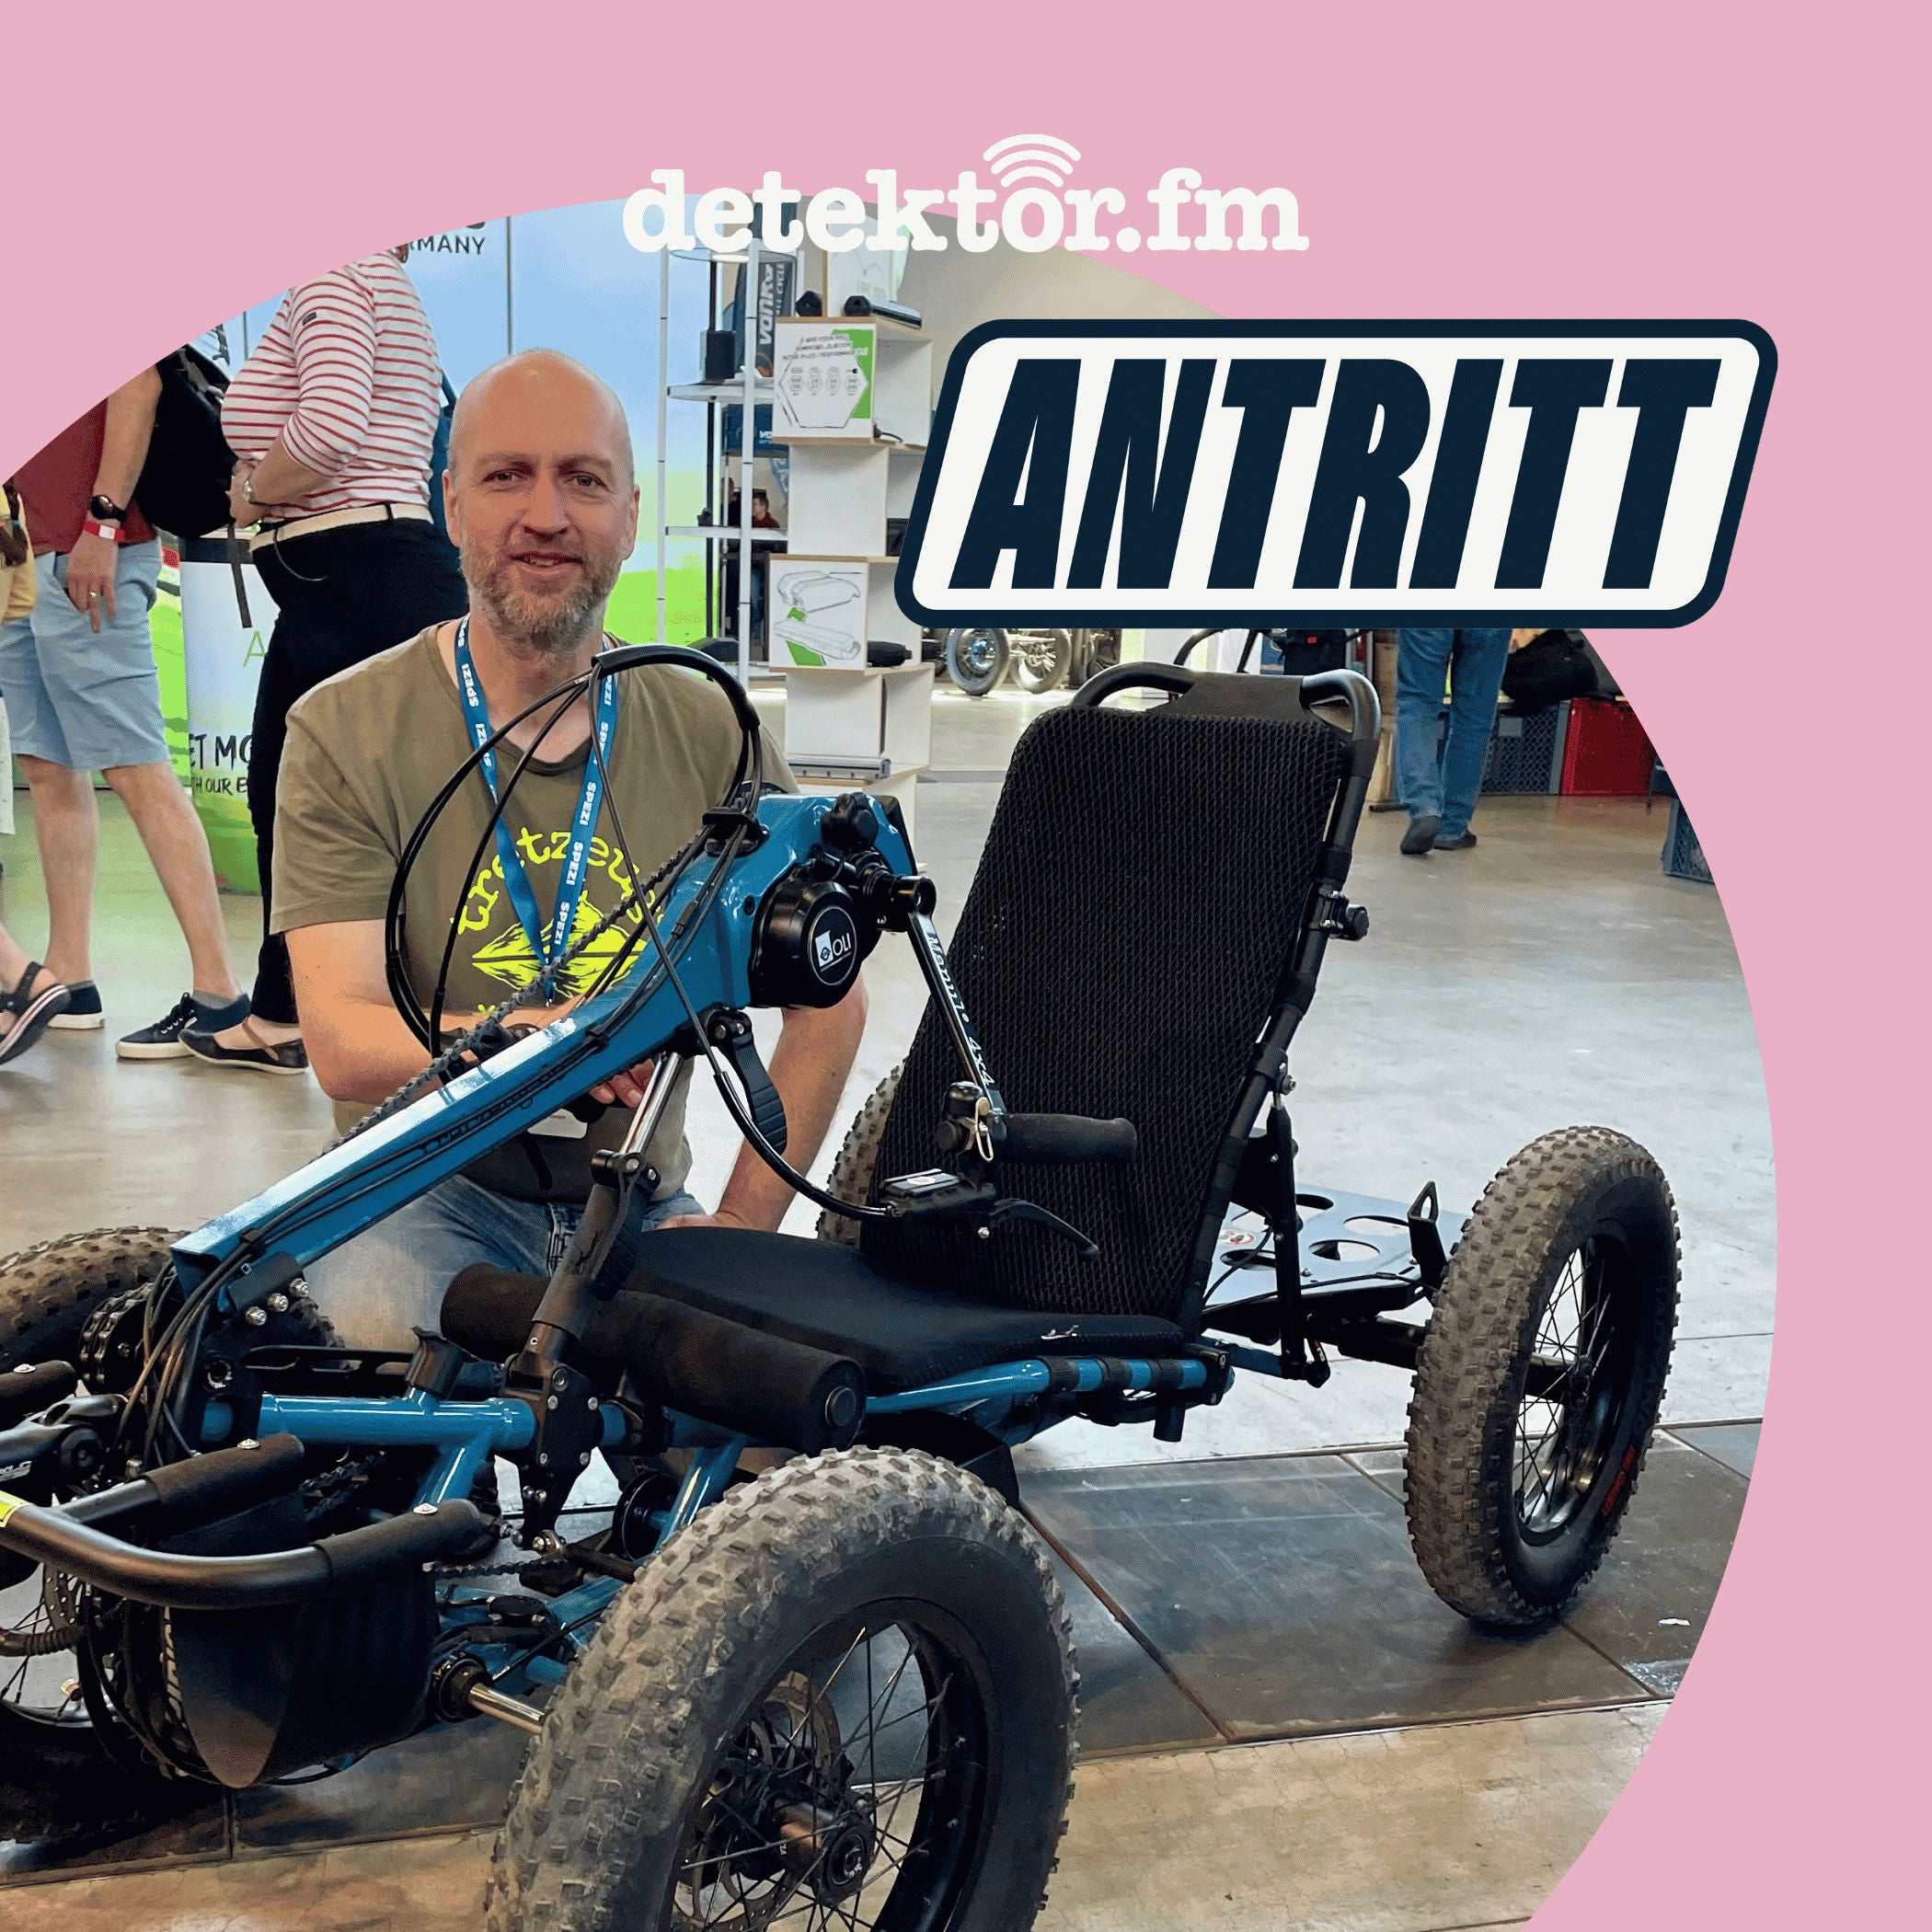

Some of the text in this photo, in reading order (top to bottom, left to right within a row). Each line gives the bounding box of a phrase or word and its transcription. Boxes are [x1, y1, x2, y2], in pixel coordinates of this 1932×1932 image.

[409, 235, 487, 255] MANY
[462, 663, 479, 707] SPEZI
[580, 781, 597, 826] SPEZI
[566, 841, 584, 885] SPEZI
[554, 901, 570, 945] SPEZI
[832, 932, 852, 957] OLI
